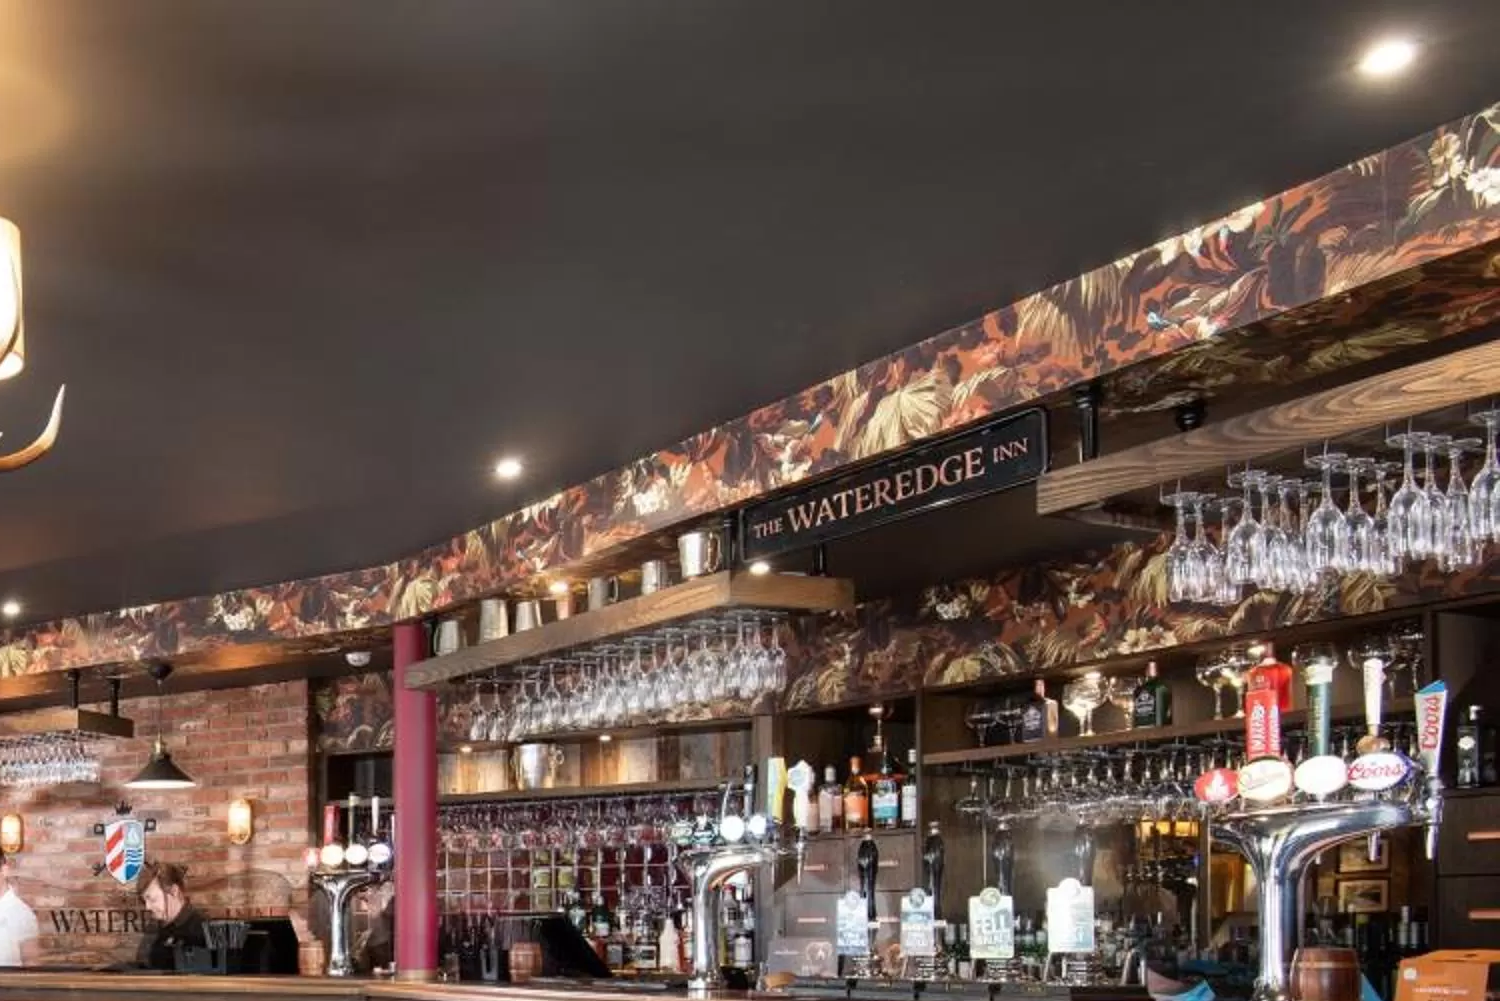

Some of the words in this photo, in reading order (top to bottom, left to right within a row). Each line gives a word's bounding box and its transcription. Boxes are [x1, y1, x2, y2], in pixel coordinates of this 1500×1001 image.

[754, 518, 783, 538] THE
[788, 447, 985, 532] WATEREDGE
[993, 437, 1028, 463] INN
[50, 909, 152, 933] WATERE
